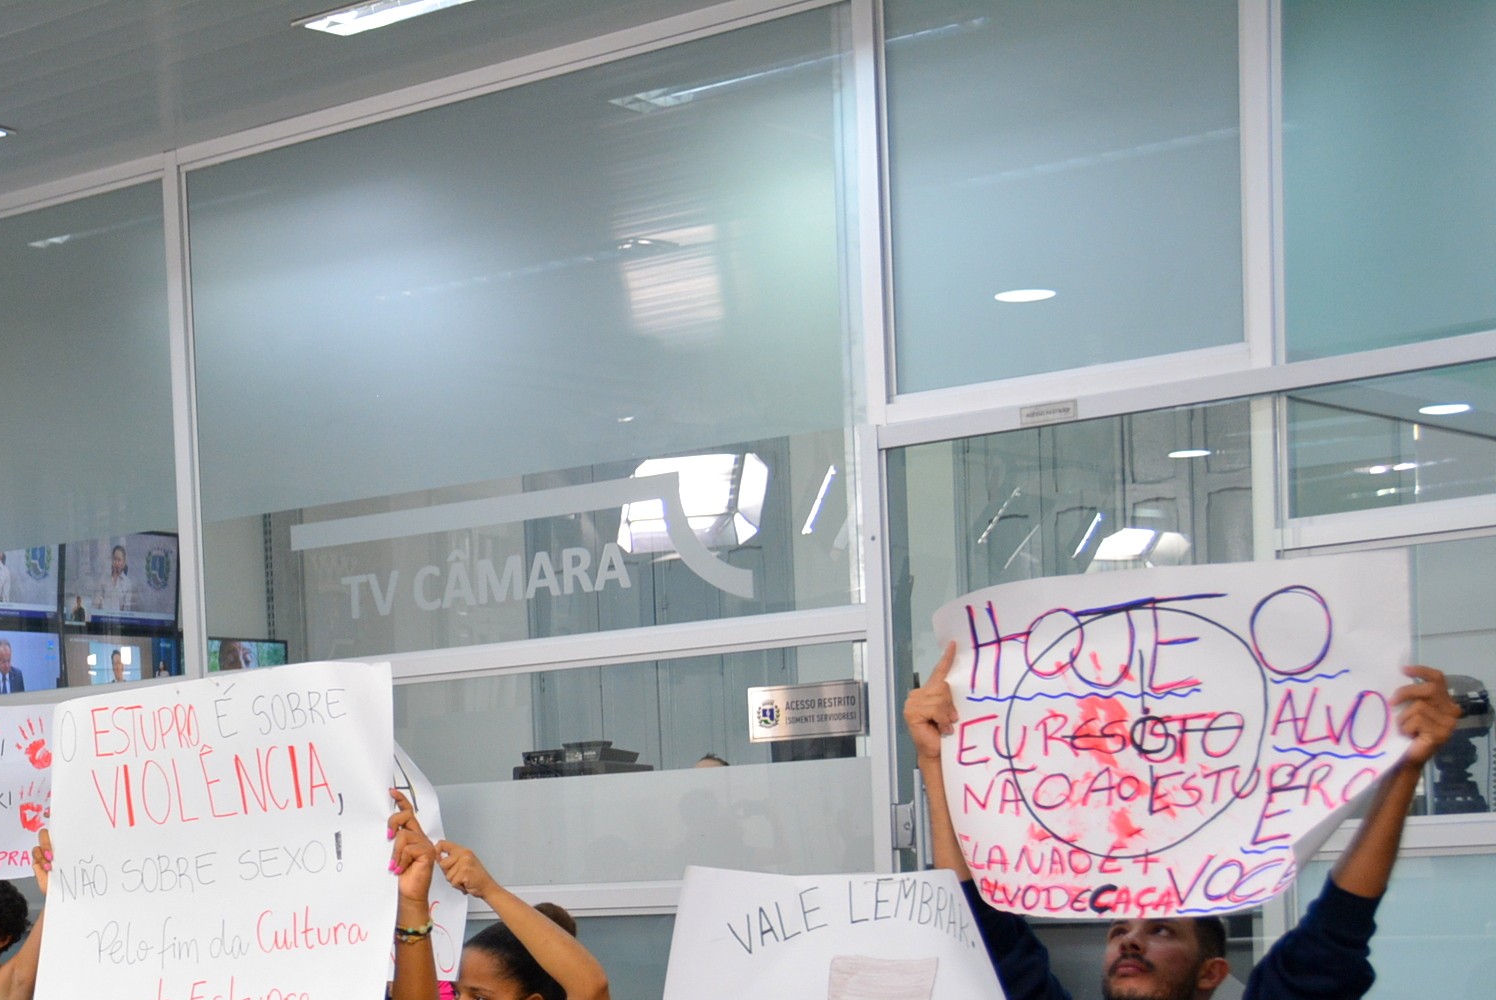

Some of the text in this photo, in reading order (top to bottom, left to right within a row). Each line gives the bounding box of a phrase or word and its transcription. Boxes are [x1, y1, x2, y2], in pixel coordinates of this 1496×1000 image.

[341, 542, 632, 619] TV CÂMARA
[965, 584, 1332, 693] HOJE O
[61, 683, 347, 763] O ESTUPRO É SOBRE
[785, 695, 856, 711] ACESSO RESTRITO
[1270, 688, 1391, 755] ALVO
[957, 714, 1027, 767] EU
[91, 742, 345, 829] VIOLÊNCIA,
[963, 766, 1072, 816] NÃO
[1148, 763, 1380, 816] ESTUPRO
[59, 856, 108, 903] NÃO
[121, 851, 218, 894] SOBRE
[86, 905, 369, 969] Pelo fim da Cultura
[727, 886, 828, 955] VALE
